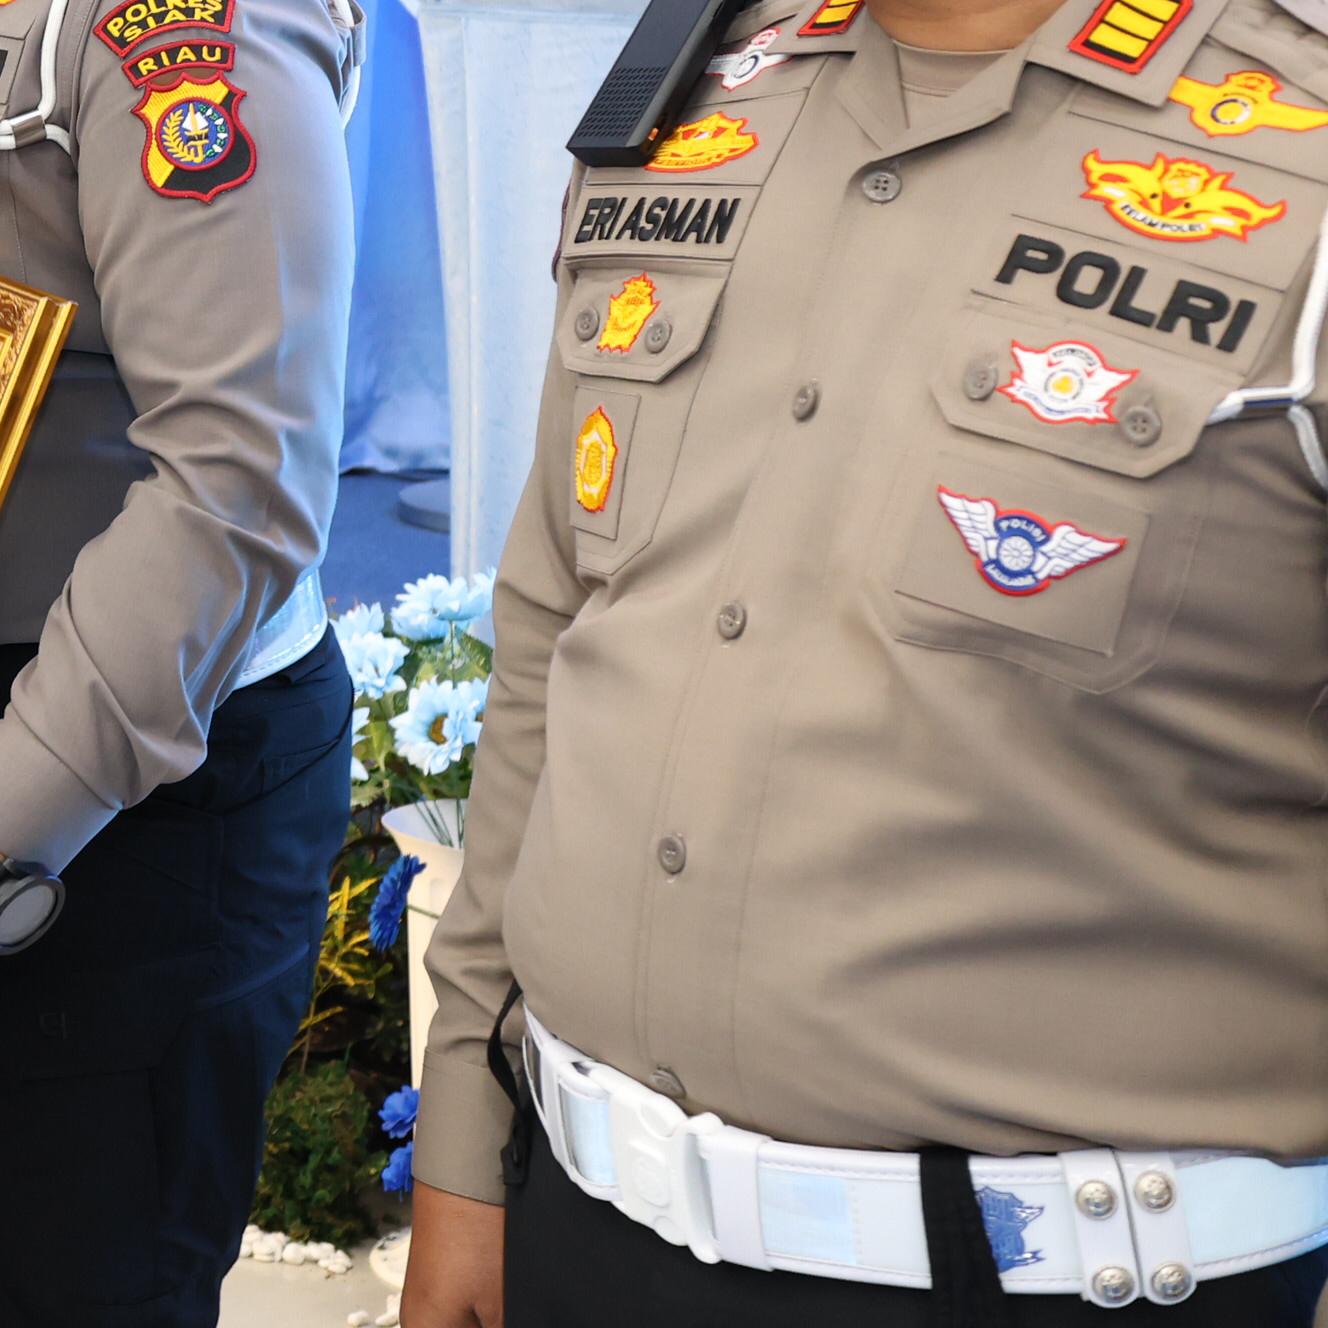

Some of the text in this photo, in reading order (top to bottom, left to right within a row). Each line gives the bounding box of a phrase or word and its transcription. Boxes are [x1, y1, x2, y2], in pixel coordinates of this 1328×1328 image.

[123, 7, 215, 43] SIAK
[137, 45, 222, 76] RIAU
[993, 233, 1258, 354] POLRI
